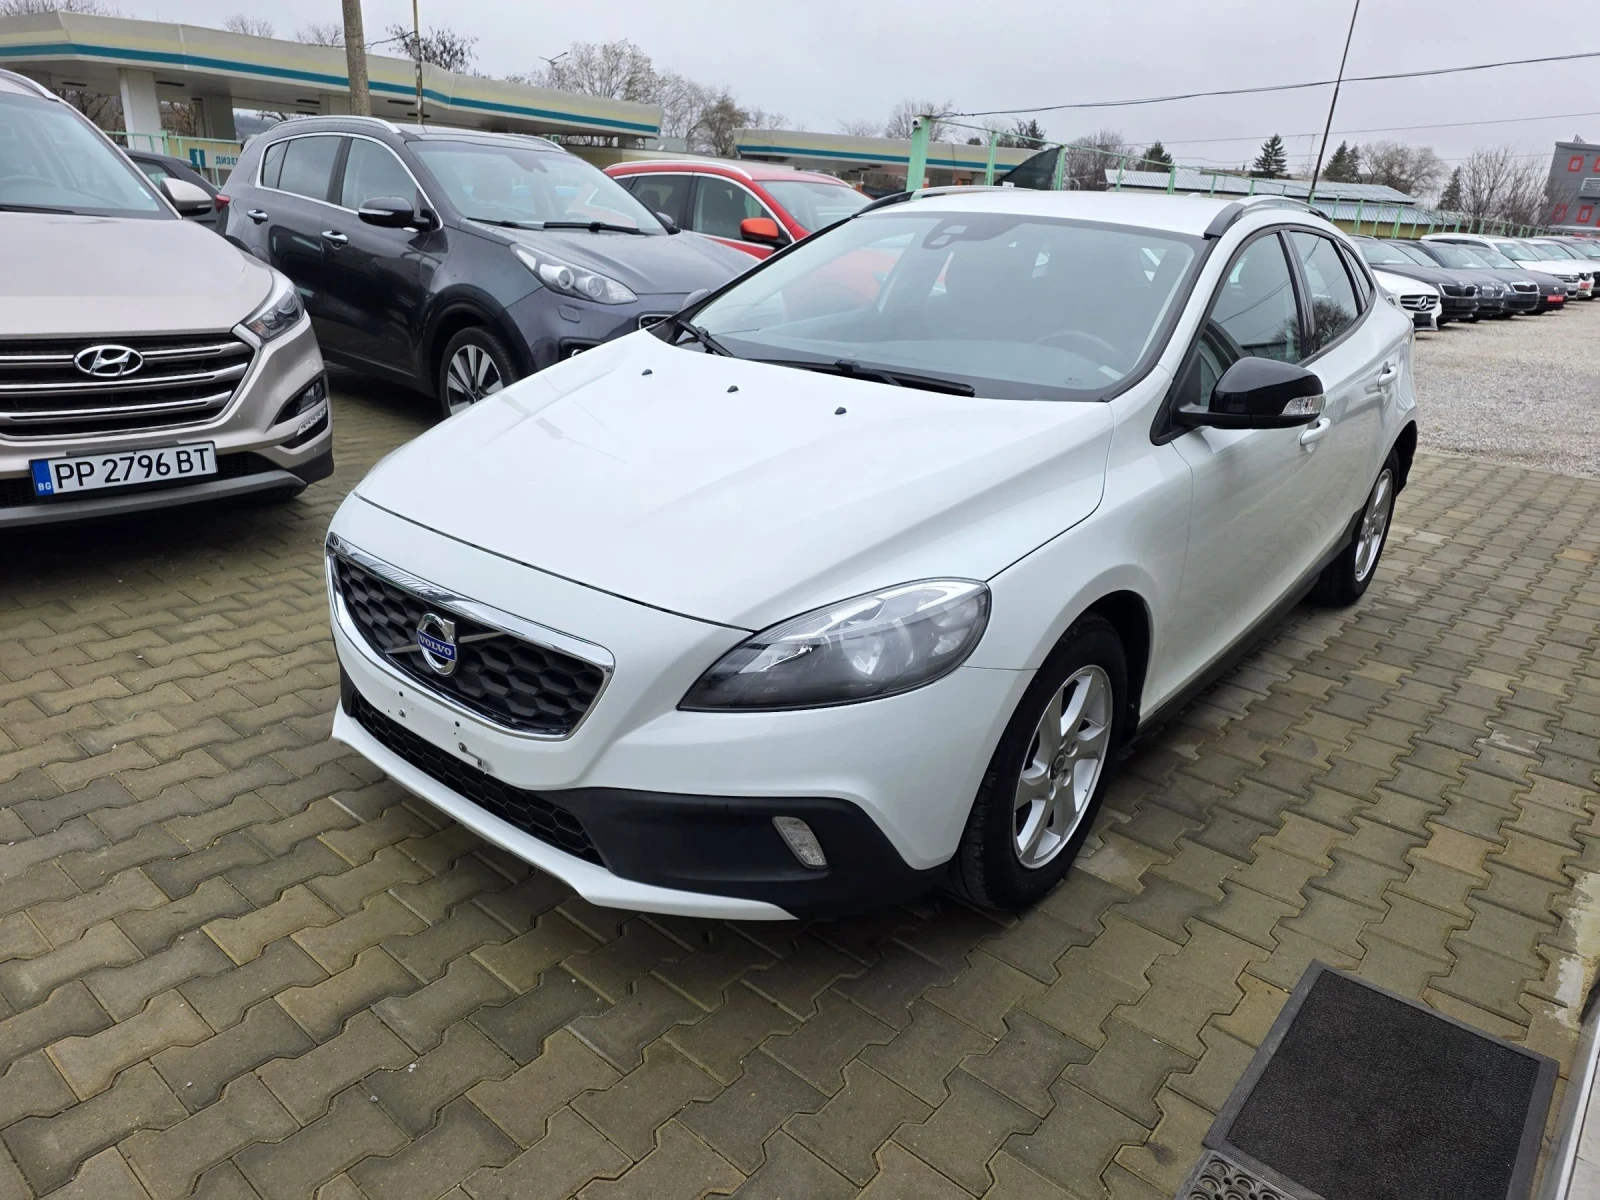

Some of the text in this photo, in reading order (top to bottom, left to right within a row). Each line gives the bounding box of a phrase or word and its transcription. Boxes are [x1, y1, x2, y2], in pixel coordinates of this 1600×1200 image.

[54, 448, 209, 489] PP 2796 BT
[38, 482, 51, 491] BG
[419, 634, 452, 656] VOLVO
